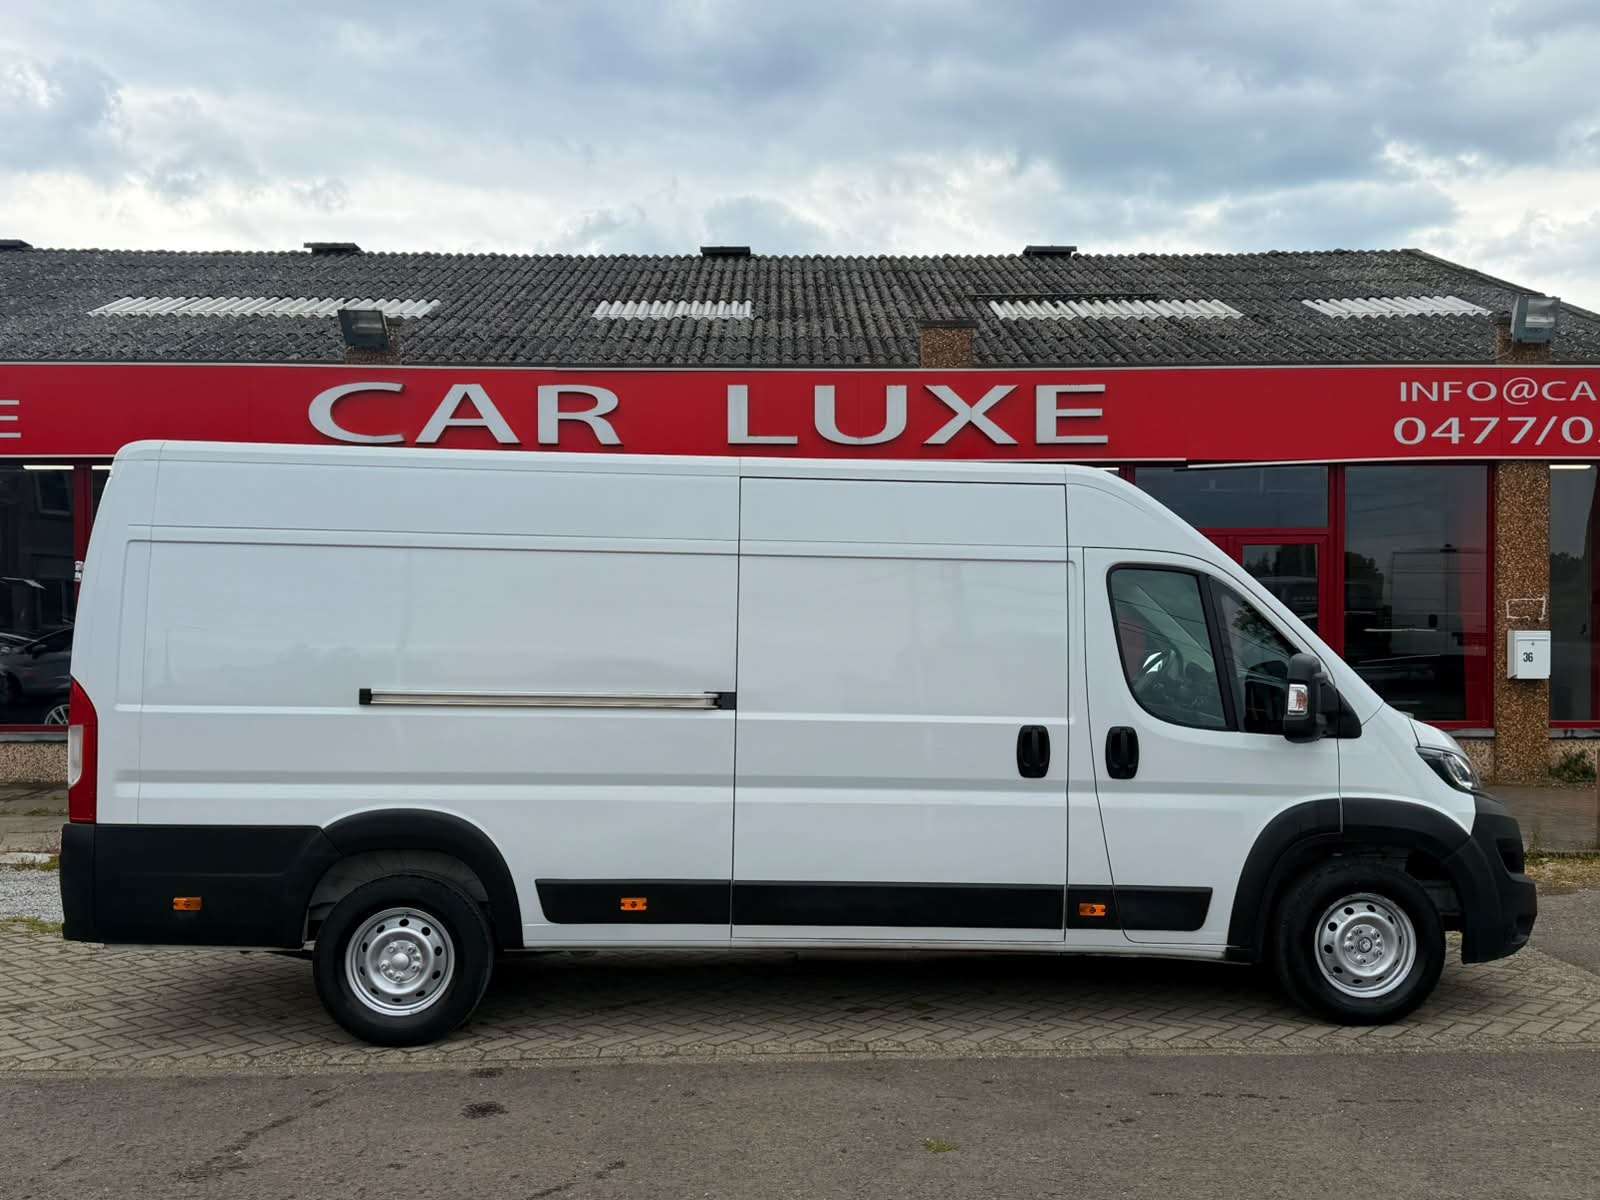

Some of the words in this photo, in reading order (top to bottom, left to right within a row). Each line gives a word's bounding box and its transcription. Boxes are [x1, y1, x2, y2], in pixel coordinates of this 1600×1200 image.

[1400, 377, 1598, 406] INFO@CA
[308, 382, 622, 446] CAR
[727, 384, 1109, 446] LUXE
[1394, 416, 1600, 446] 0477/0
[1522, 652, 1534, 663] 36
